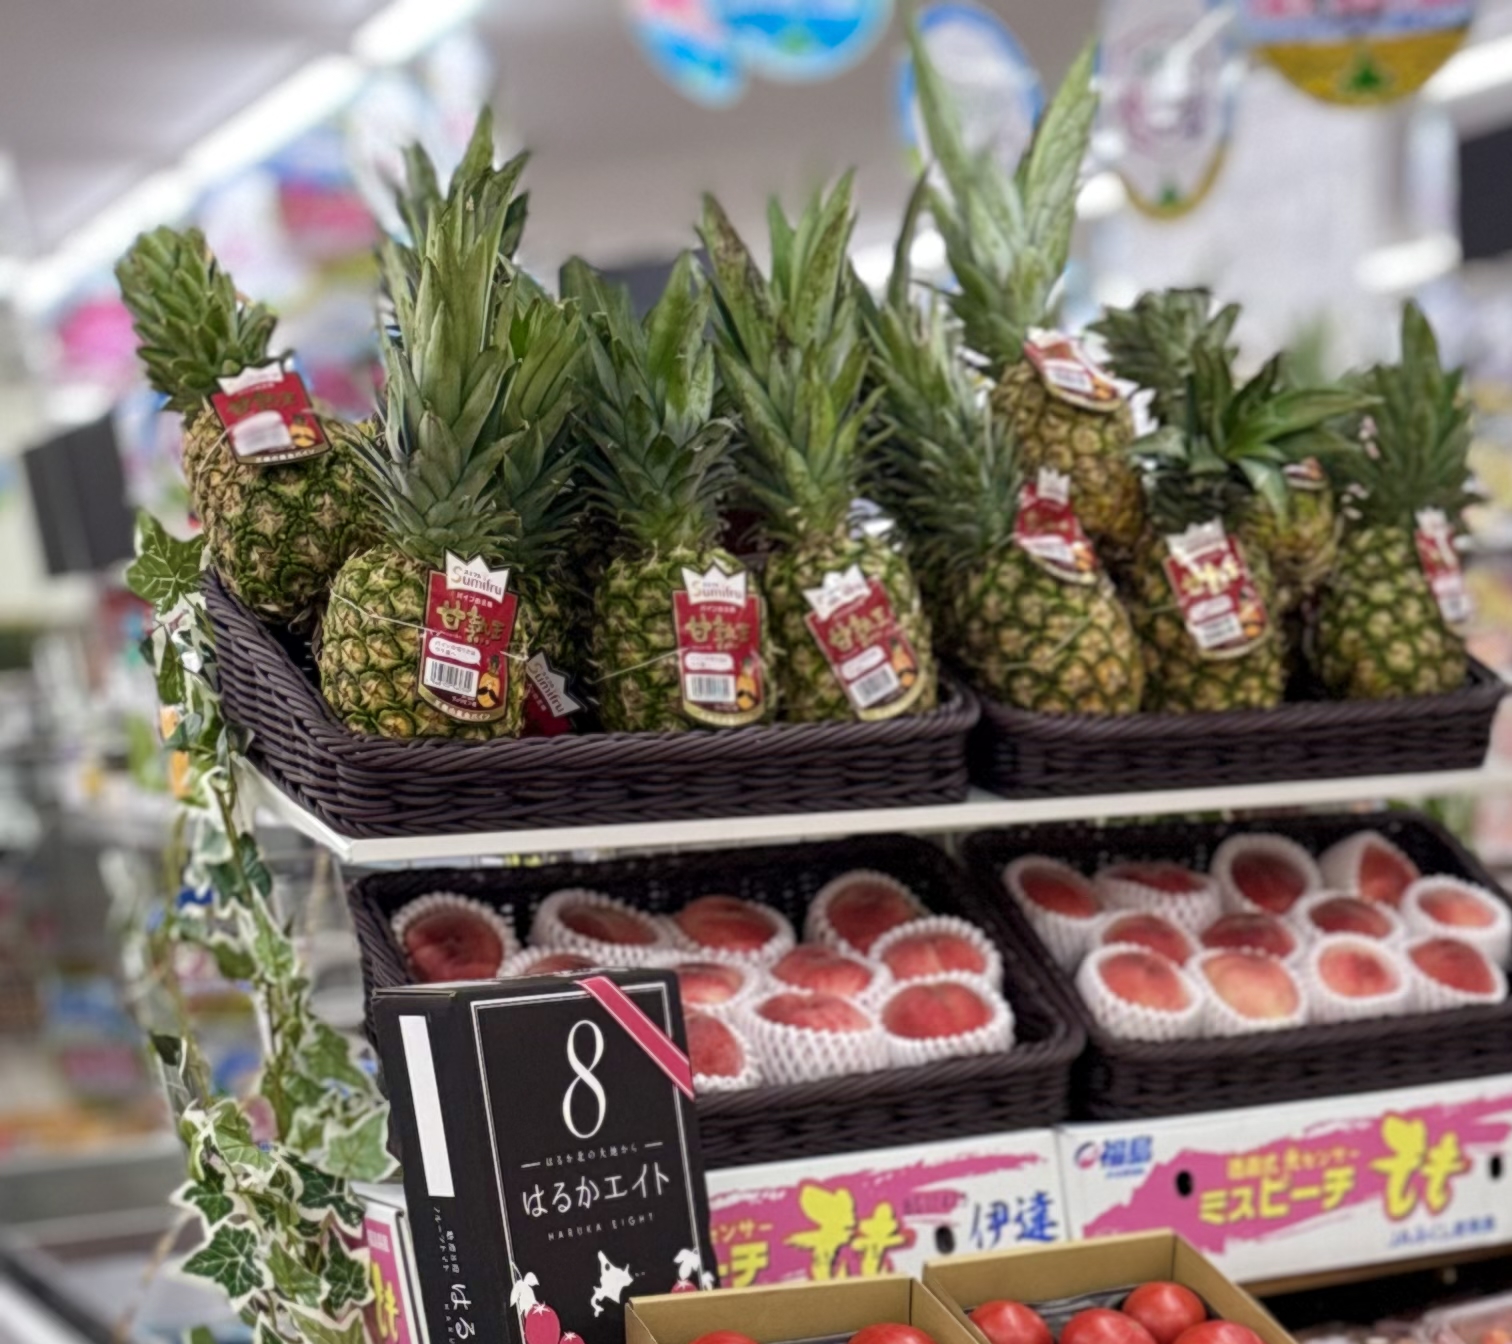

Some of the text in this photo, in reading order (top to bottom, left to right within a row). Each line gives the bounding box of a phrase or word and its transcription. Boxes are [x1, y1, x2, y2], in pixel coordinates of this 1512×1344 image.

[450, 566, 503, 596] Sumifru
[527, 662, 564, 713] Sumifru
[562, 1019, 608, 1140] 8
[1099, 1135, 1153, 1167] 福島
[522, 1161, 670, 1219] はるかエイト
[1199, 1166, 1357, 1226] ミスピーチ
[547, 1211, 655, 1242] HARUKA EIGHT
[971, 1190, 1059, 1251] 伊達
